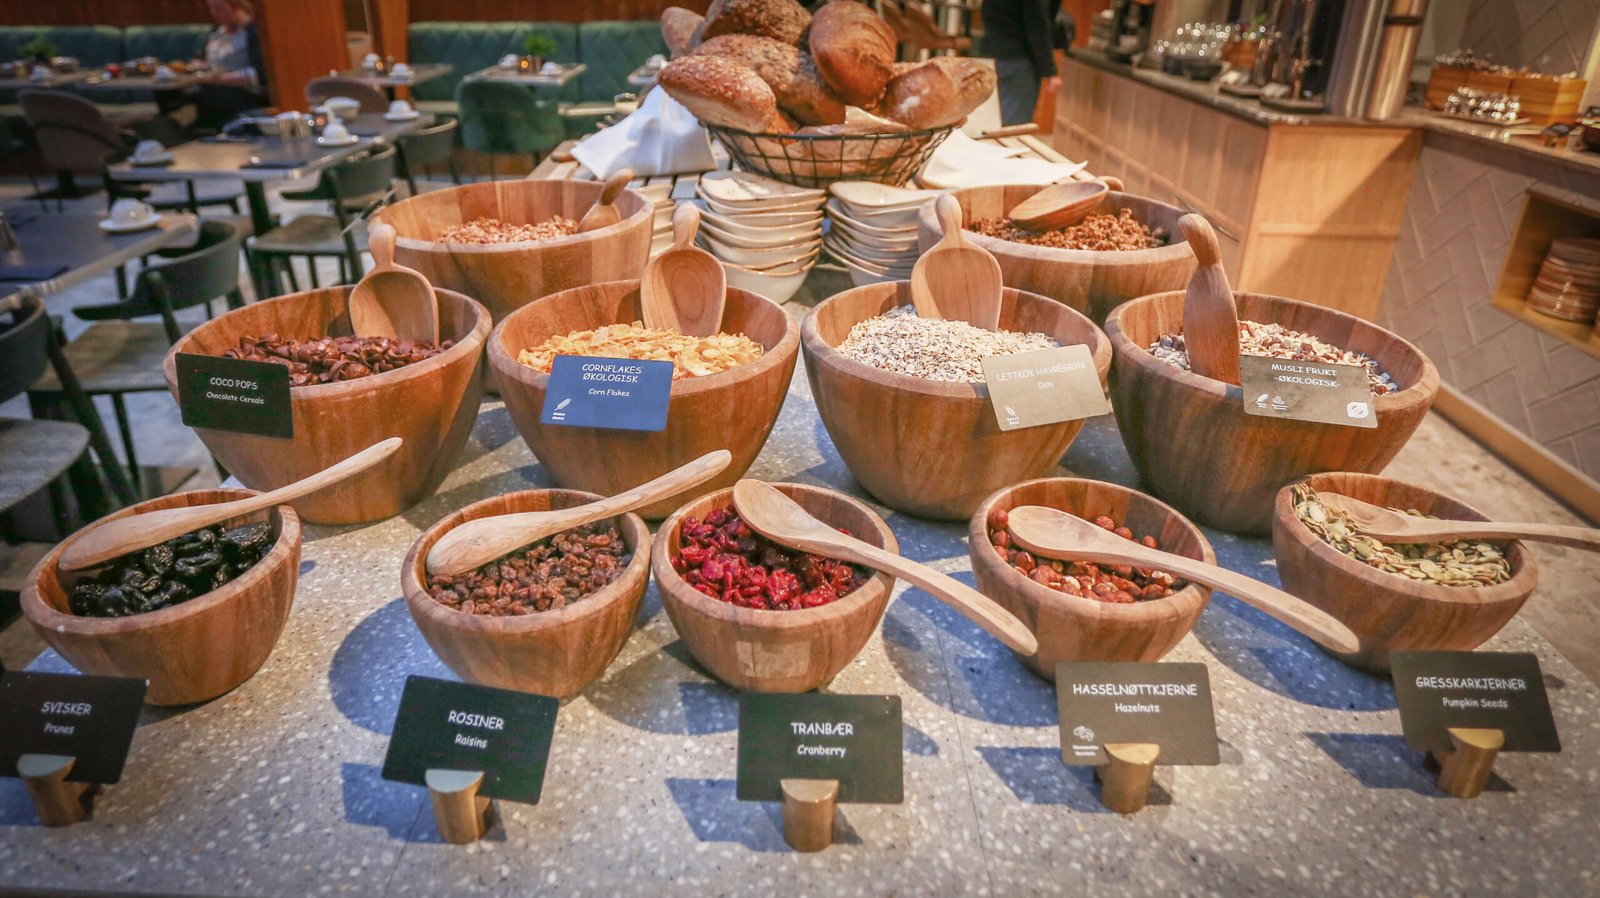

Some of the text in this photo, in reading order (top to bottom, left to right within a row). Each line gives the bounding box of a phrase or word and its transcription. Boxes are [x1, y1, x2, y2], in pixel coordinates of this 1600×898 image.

[582, 364, 642, 374] CORNFLAKES
[1272, 364, 1337, 376] MUSLI FRUKT
[582, 372, 638, 383] ØKOLOGISK
[997, 370, 1035, 382] LETTKOK
[210, 377, 258, 390] COCO POPS
[206, 392, 265, 404] Chocolate Cereals
[606, 389, 630, 397] Flakes
[1416, 676, 1526, 690] GRESSKARKJERNER
[1072, 684, 1198, 696] HASSELNØTTKJERNE
[41, 702, 92, 714] SVISKER
[1115, 702, 1160, 712] Hazelnuts
[1442, 697, 1508, 709] Pumpkin Seeds
[448, 710, 504, 730] ROSINER
[44, 722, 75, 734] Prunes
[790, 722, 854, 736] TRANBÆR
[454, 734, 488, 748] Raisins
[797, 744, 846, 758] Cranberry
